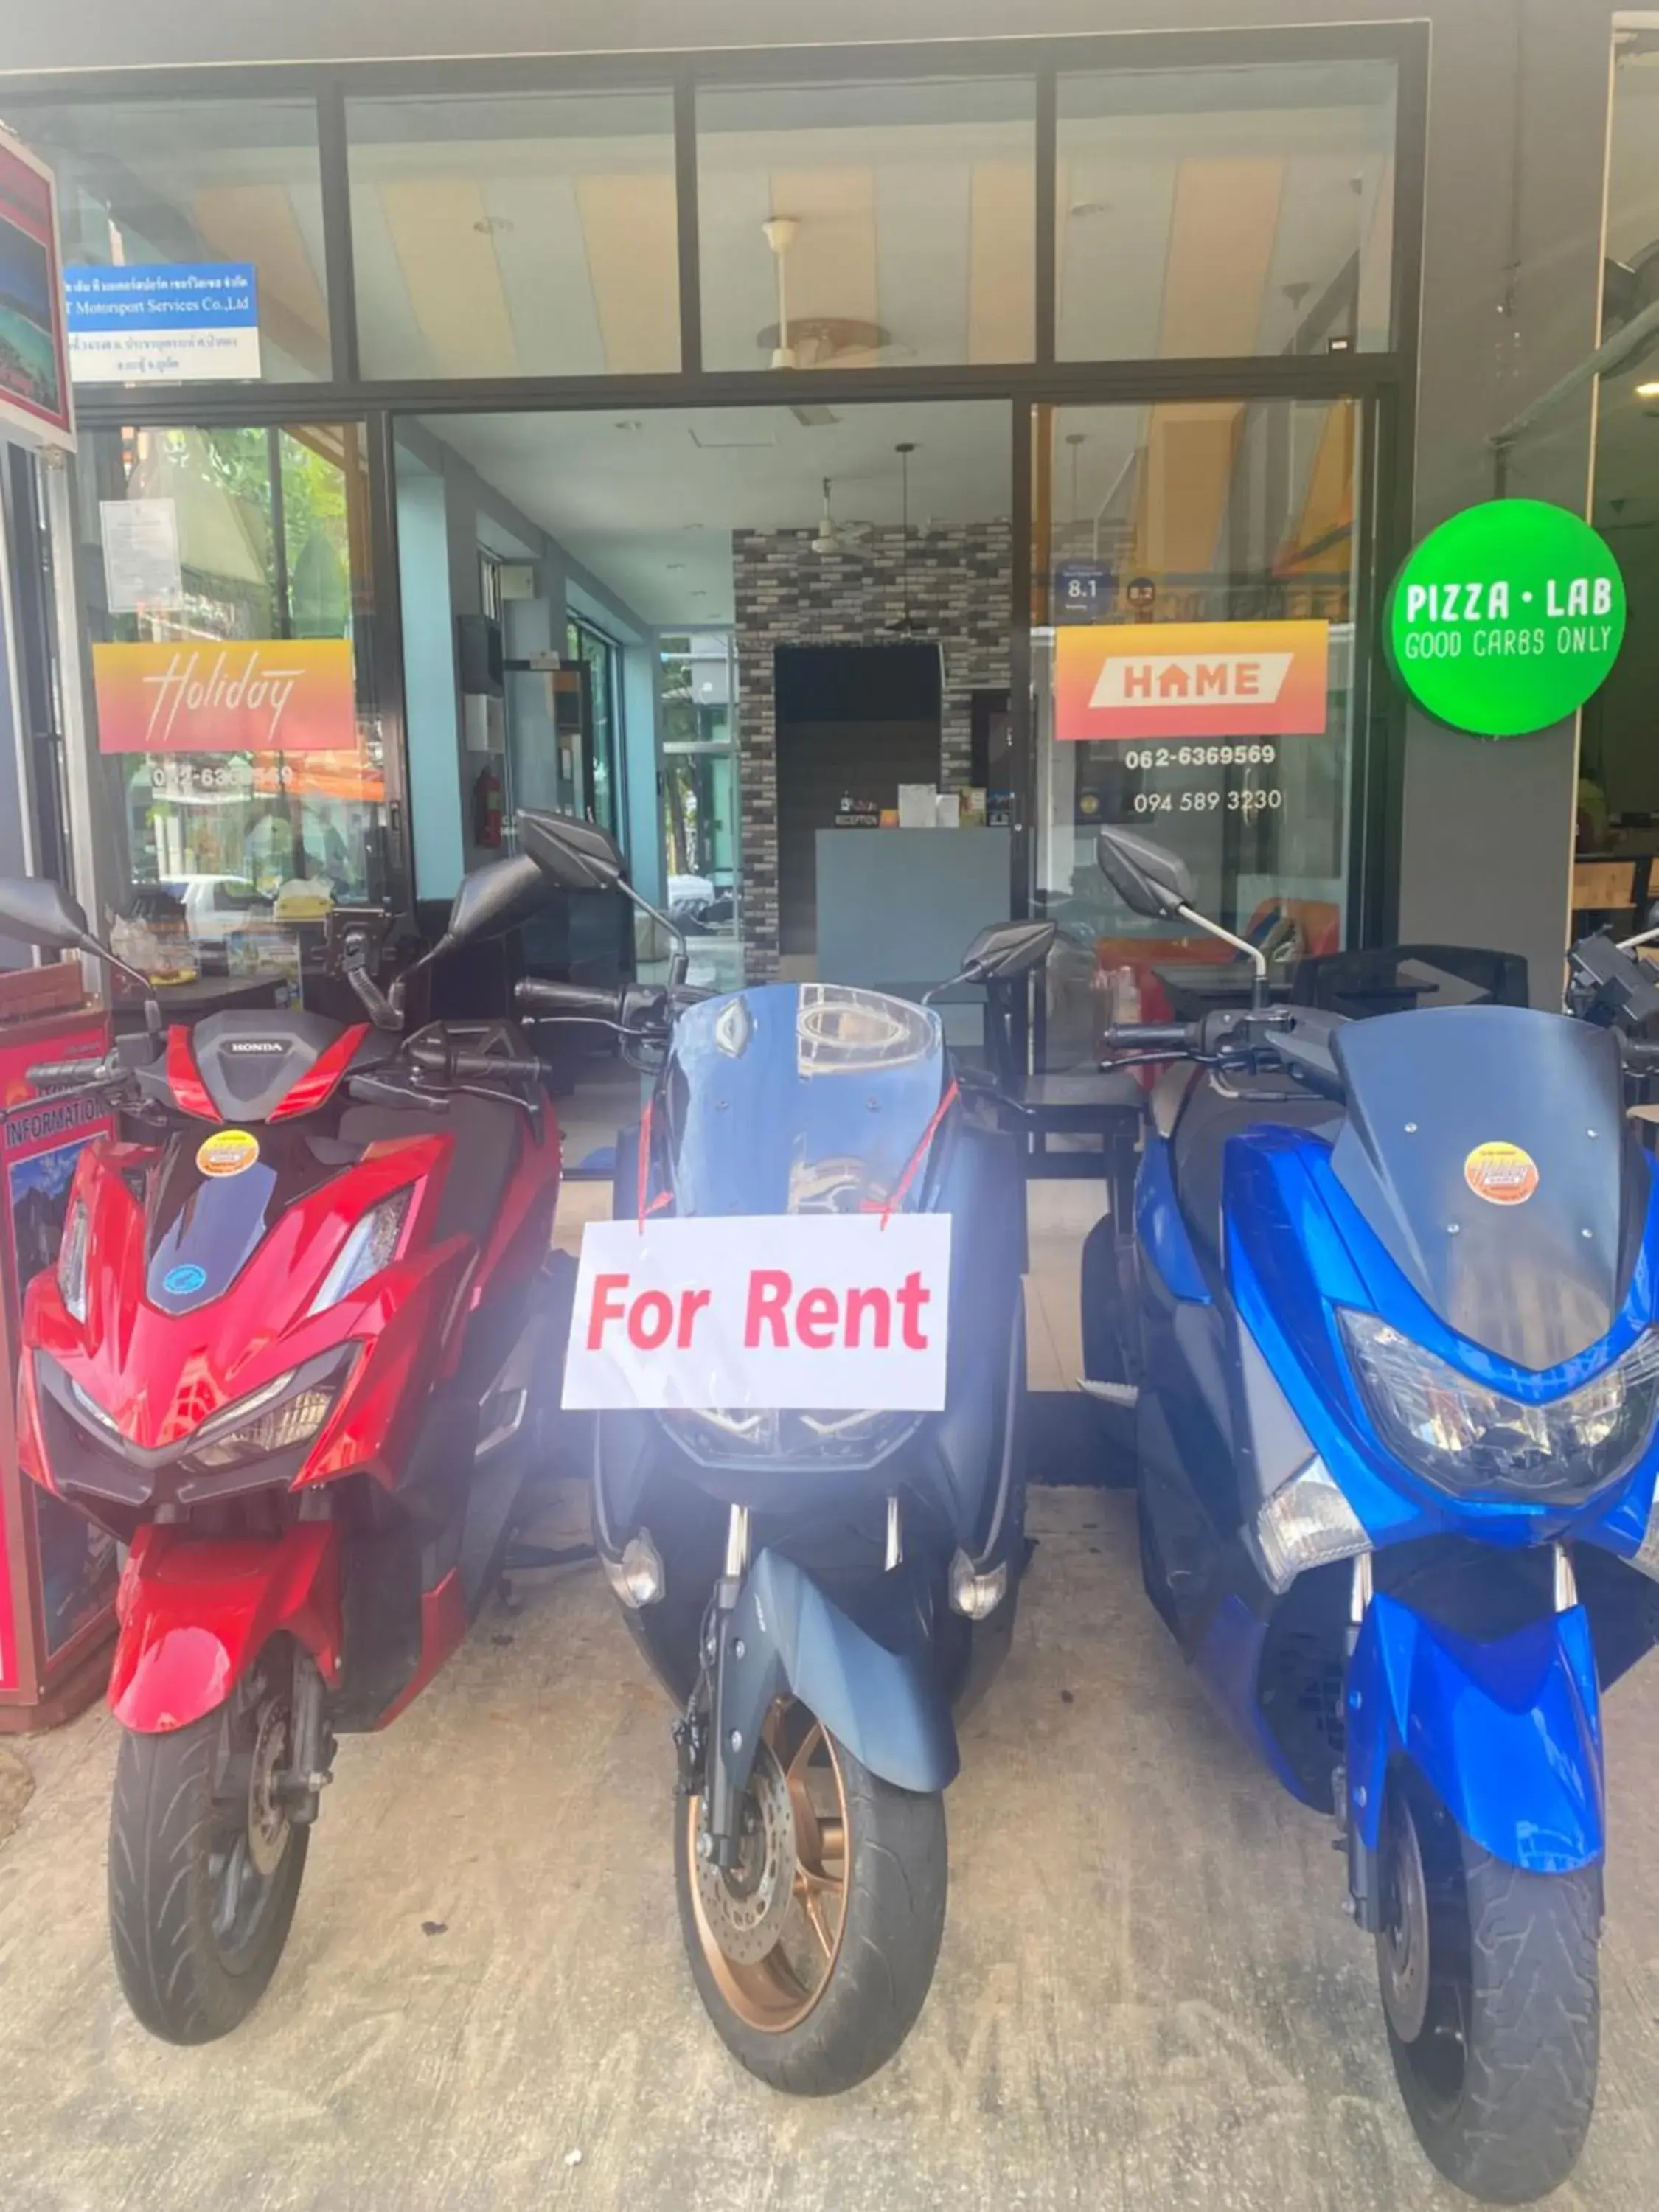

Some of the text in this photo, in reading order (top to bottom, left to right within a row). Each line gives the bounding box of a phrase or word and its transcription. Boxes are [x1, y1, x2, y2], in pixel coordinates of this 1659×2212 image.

[76, 301, 145, 317] Motorsport
[147, 298, 199, 313] Services
[1068, 579, 1096, 598] 8.1
[1406, 577, 1613, 623] PIZZA LAB
[1405, 625, 1613, 660] GOOD CARBS ONLY
[142, 650, 306, 743] Holiday
[1125, 745, 1276, 769] 062-6369569
[1133, 789, 1282, 813] 094 589 3230
[232, 1043, 283, 1052] HONDA
[586, 1269, 931, 1351] For Rent
